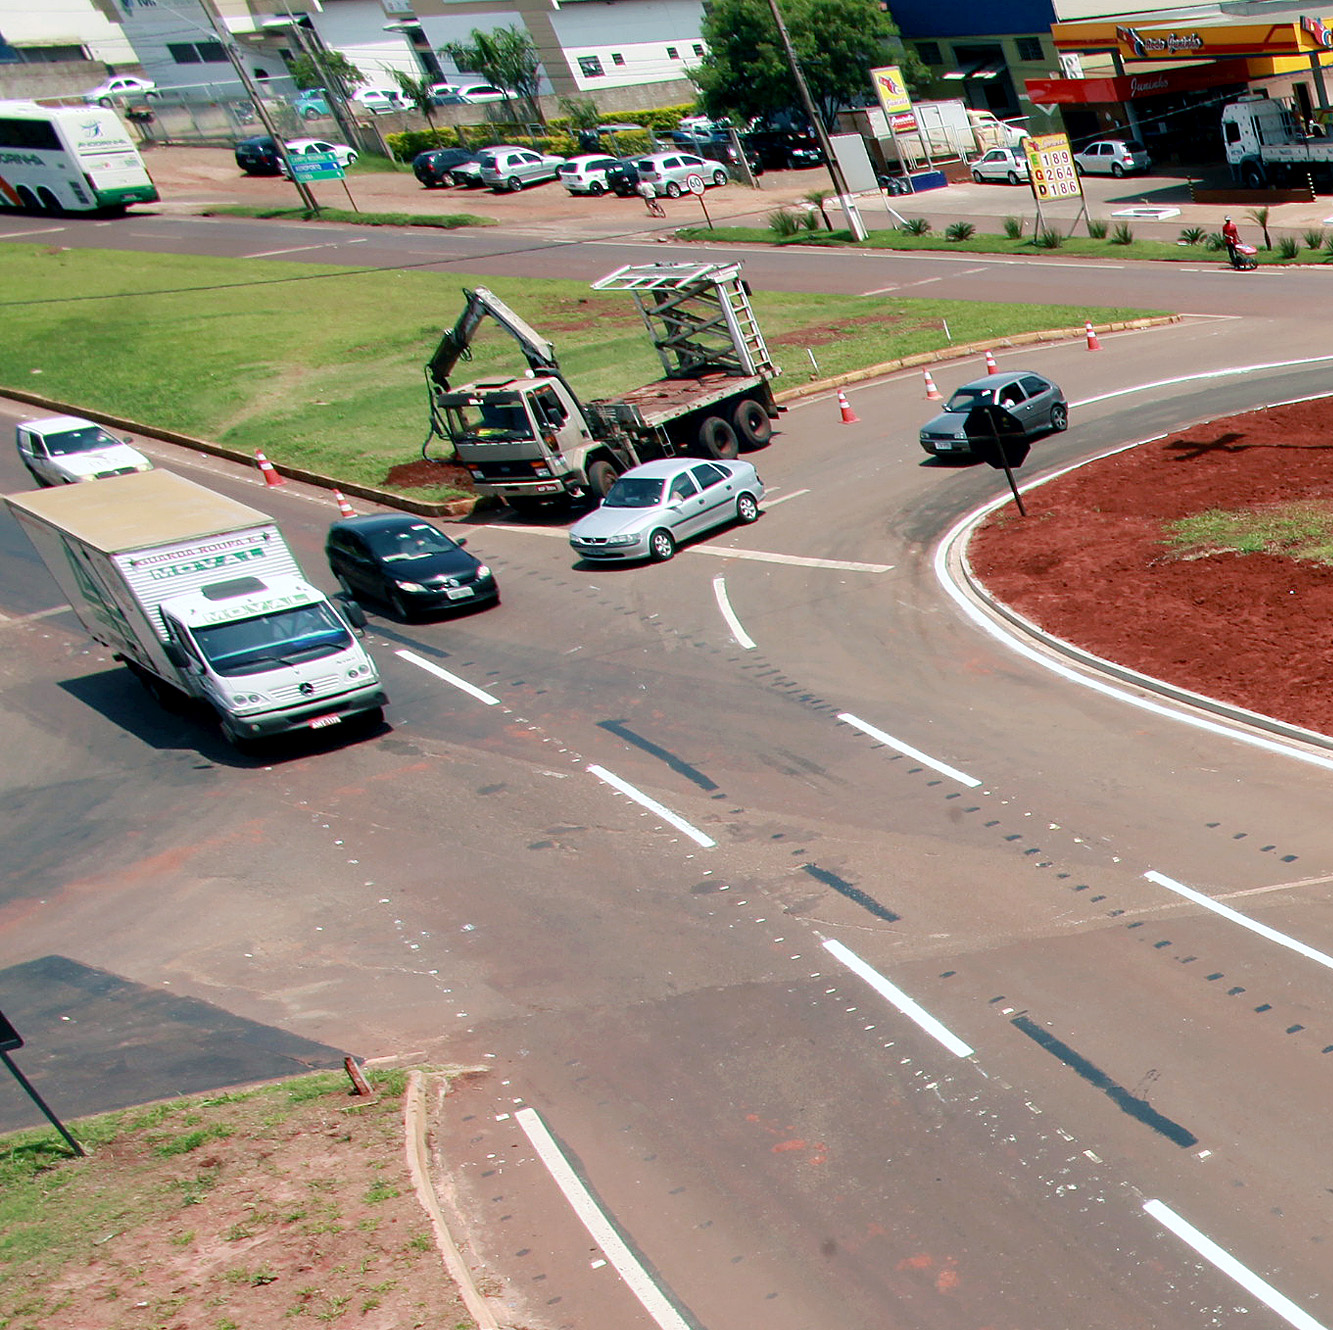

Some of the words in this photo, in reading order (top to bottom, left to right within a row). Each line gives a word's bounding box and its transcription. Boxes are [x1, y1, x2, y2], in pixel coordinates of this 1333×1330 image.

[689, 177, 701, 187] 60
[152, 548, 267, 580] MOVAL
[203, 594, 311, 623] MOVAL
